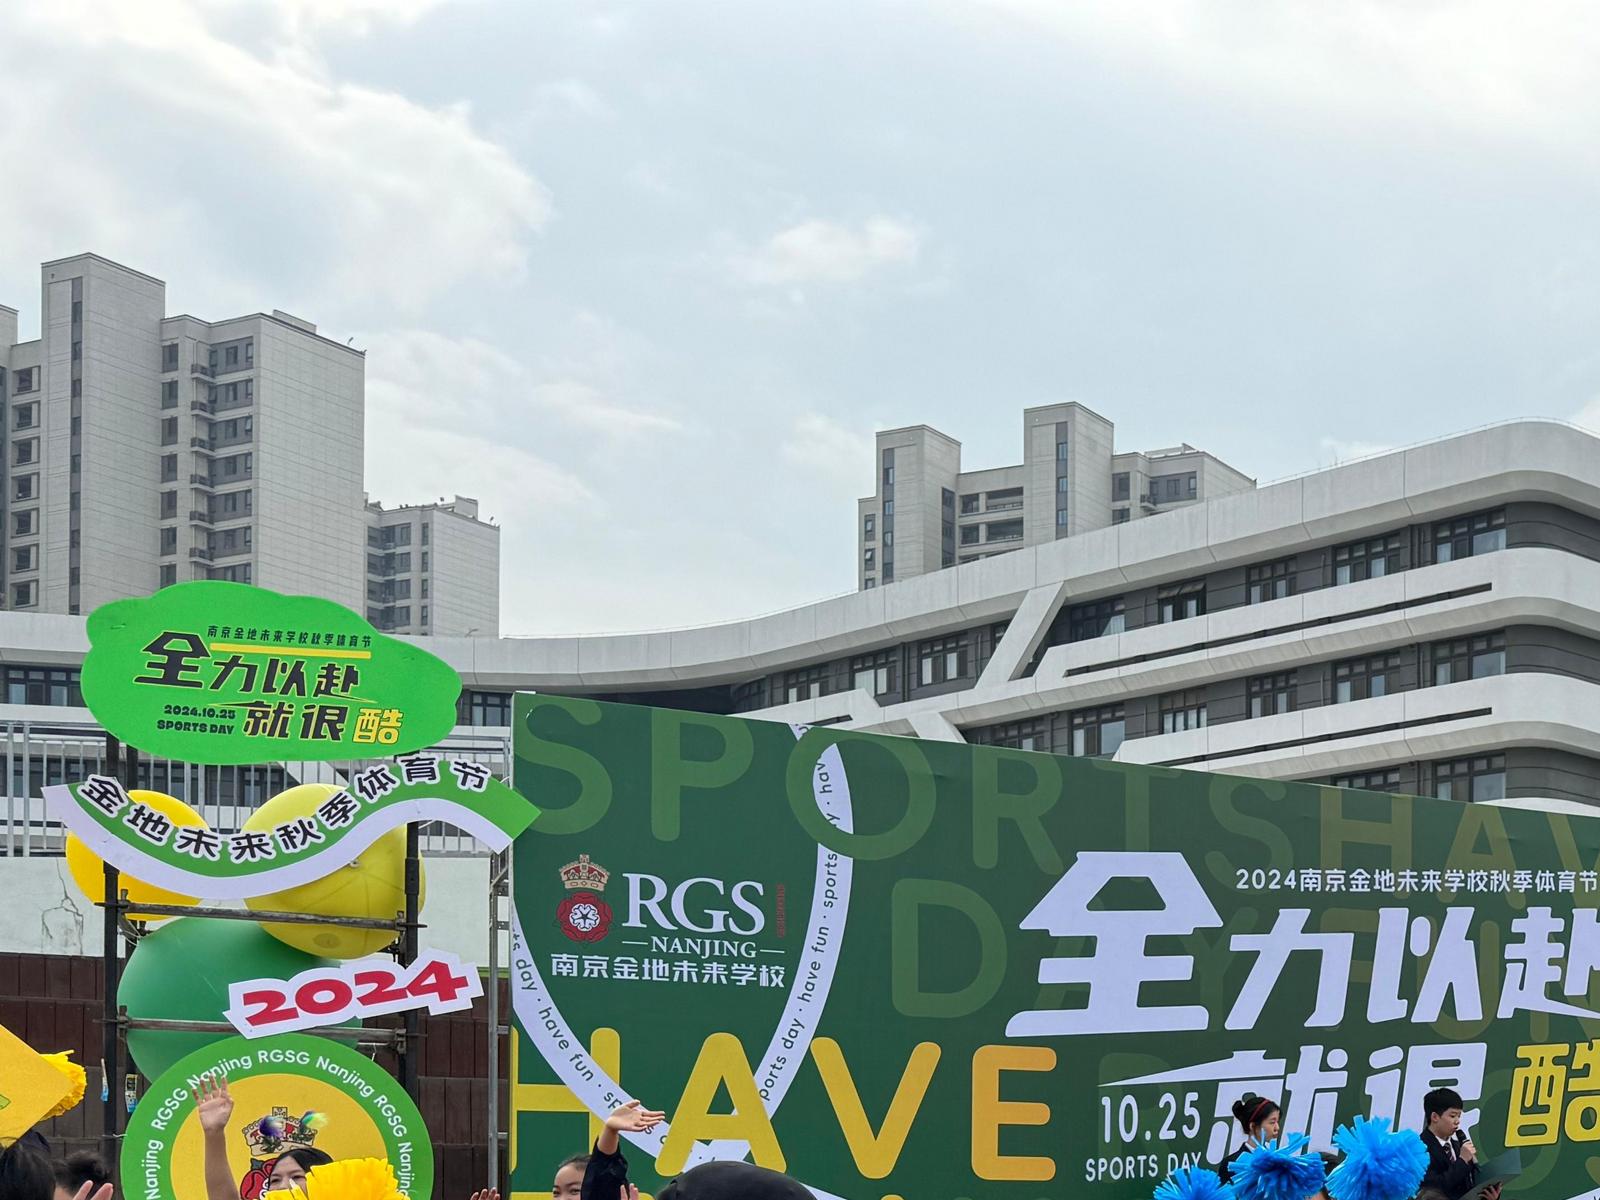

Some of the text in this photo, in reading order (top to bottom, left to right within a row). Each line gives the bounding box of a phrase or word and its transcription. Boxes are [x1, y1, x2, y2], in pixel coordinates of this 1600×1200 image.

[133, 631, 377, 703] 全力以赴
[157, 719, 235, 735] SPORTS DAY
[164, 704, 236, 720] 2024.10.25
[207, 700, 404, 744] 就很酷
[82, 757, 490, 860] 金地未来秋季体育节
[1236, 868, 1598, 893] 2024南京金地未来学校秋季体育节
[622, 873, 765, 936] RGS
[651, 936, 757, 959] NANJING
[551, 953, 785, 988] 南京金地未来学校
[759, 1056, 786, 1101] ports
[782, 1018, 804, 1049] day
[797, 961, 820, 1002] have
[811, 926, 829, 953] fun
[824, 853, 838, 909] sports
[242, 960, 468, 1027] 2024
[516, 959, 537, 990] day
[539, 1007, 570, 1050] have
[569, 1053, 594, 1081] fun
[258, 1050, 310, 1064] RGSG
[316, 1056, 375, 1097] Nanjing
[151, 1088, 188, 1130] RGSG
[374, 1095, 407, 1137] RGSG
[511, 1027, 1057, 1180] HAVE
[1101, 1092, 1200, 1143] 10.25
[141, 1140, 163, 1200] Nanjing
[1085, 1152, 1201, 1182] SPORTS DAY
